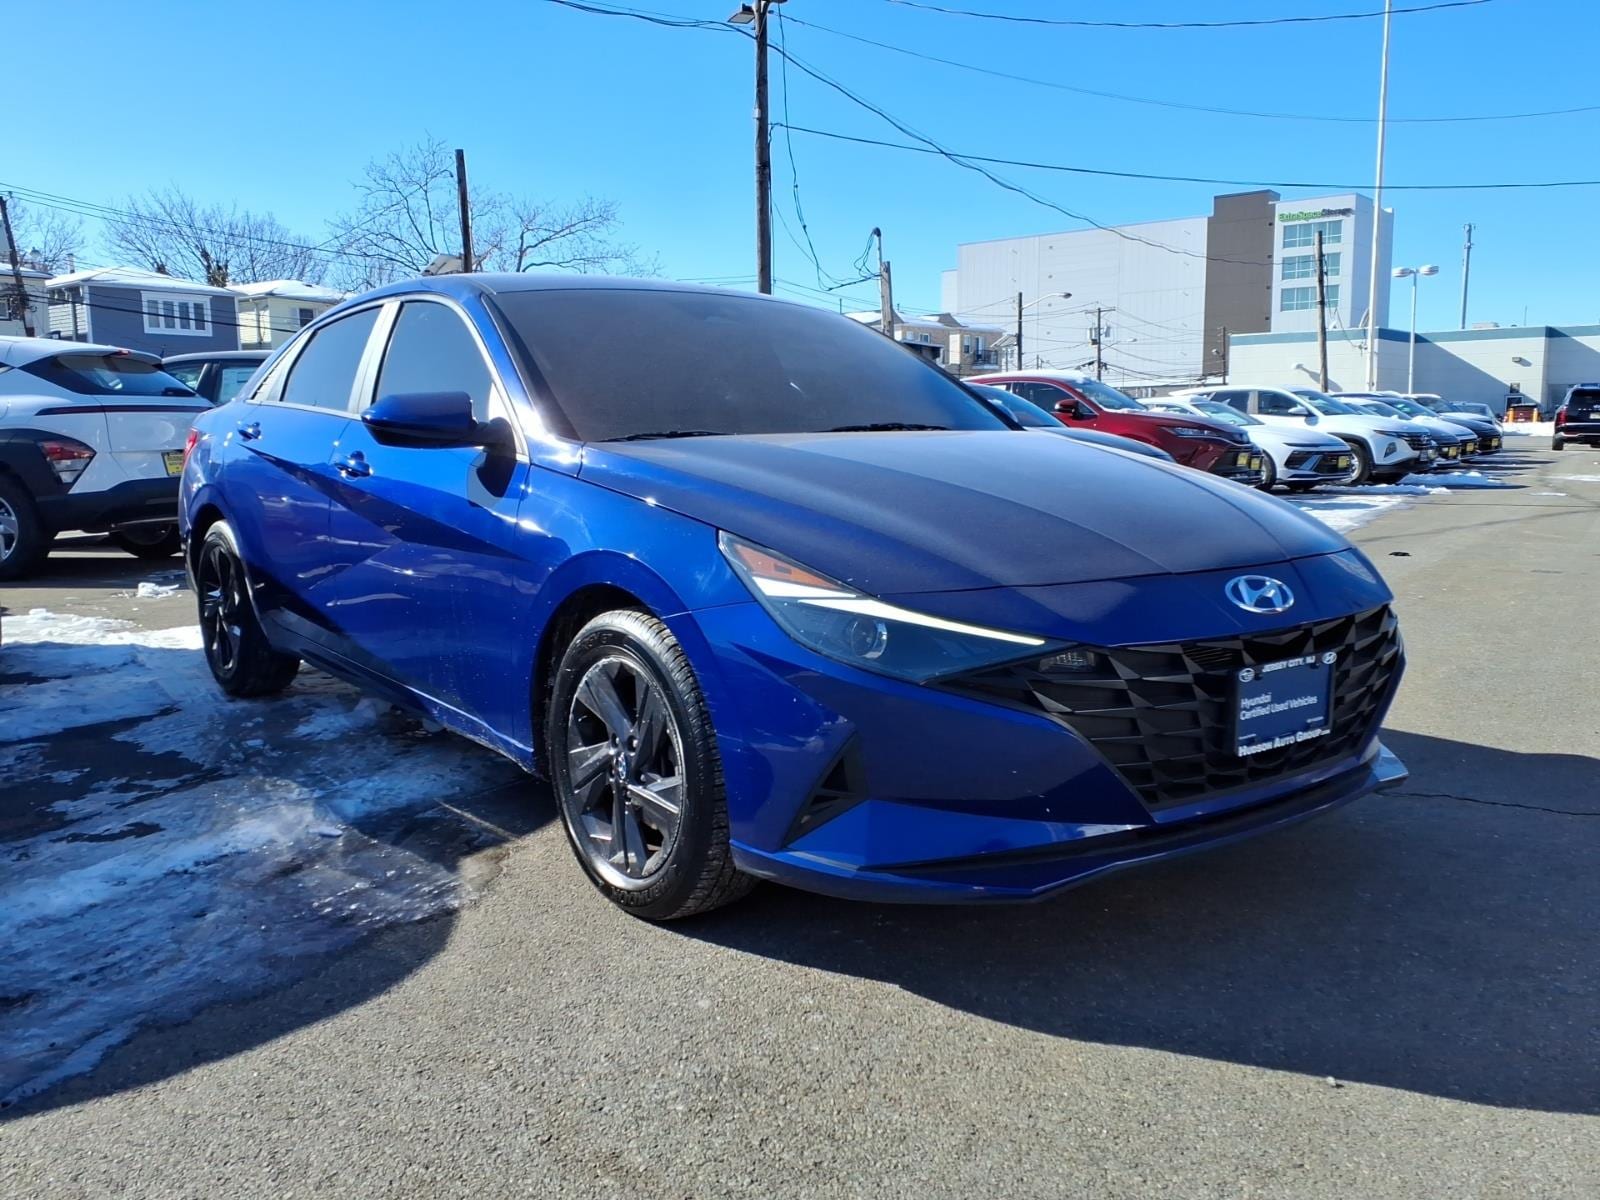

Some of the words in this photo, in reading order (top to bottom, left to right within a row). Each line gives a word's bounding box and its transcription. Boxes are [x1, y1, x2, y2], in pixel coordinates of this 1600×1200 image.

[1262, 661, 1288, 673] JERSEY
[1240, 692, 1272, 709] Hyundai
[1240, 705, 1271, 720] Certified
[1271, 700, 1290, 713] Used
[1290, 696, 1318, 708] Vehicles
